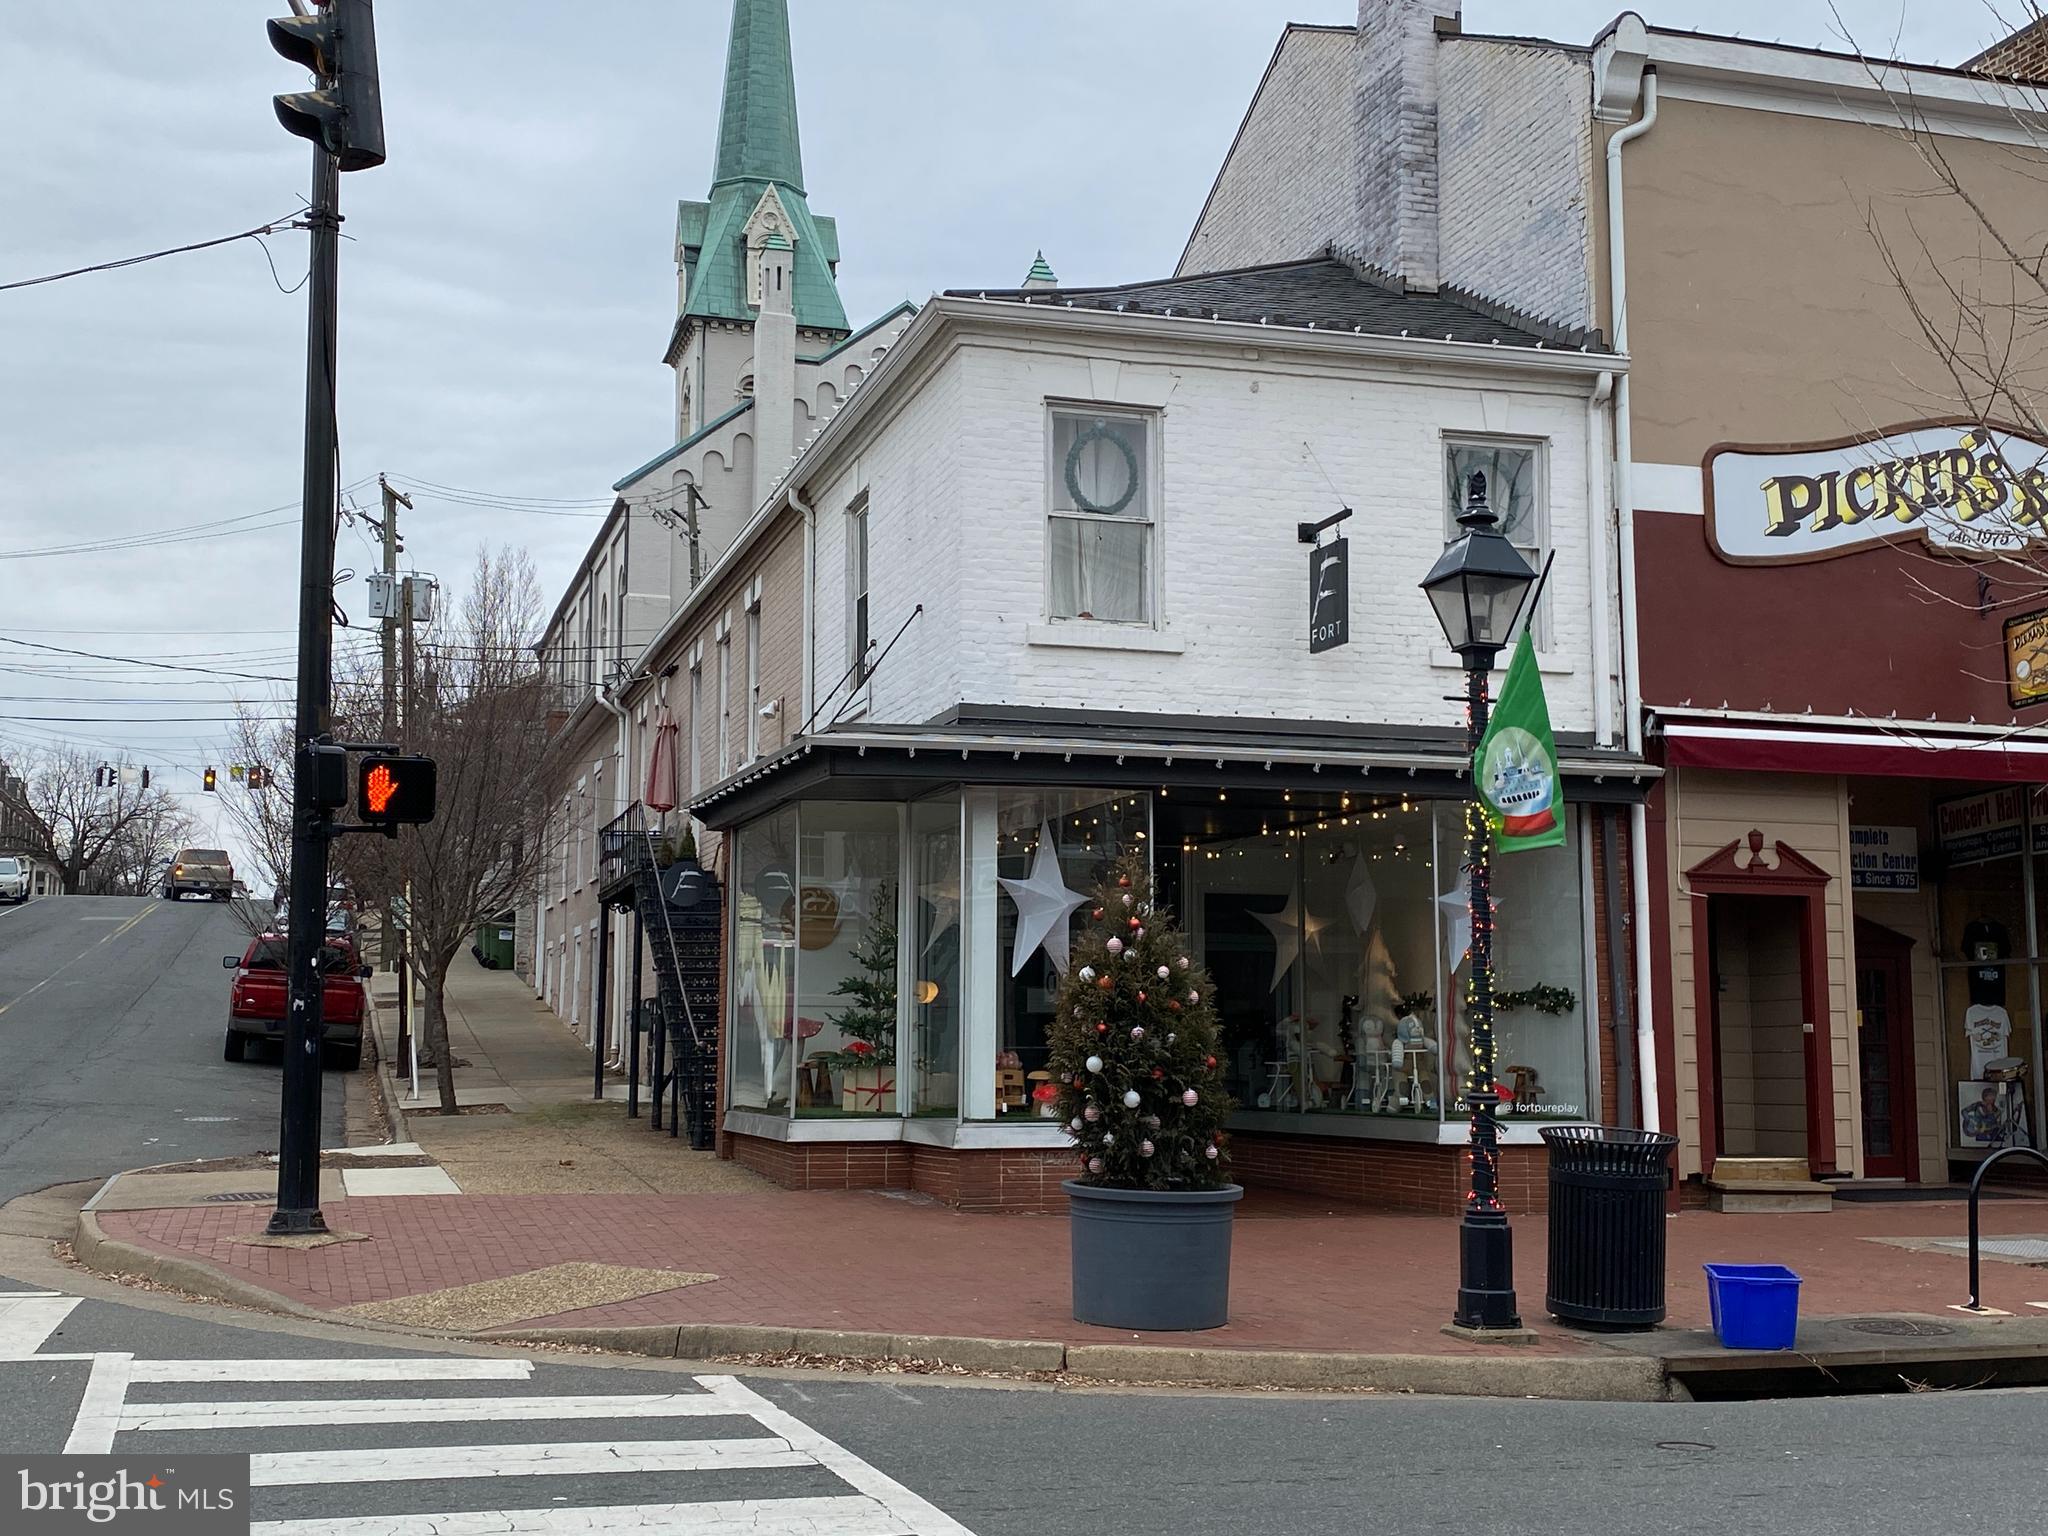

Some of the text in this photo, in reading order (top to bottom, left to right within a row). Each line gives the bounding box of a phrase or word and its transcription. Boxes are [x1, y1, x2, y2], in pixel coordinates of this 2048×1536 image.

[1760, 427, 2008, 538] PICKER'S
[1976, 528, 2010, 547] 1975
[1311, 620, 1342, 644] FORT
[1941, 788, 2021, 835] Concert Hall
[1850, 827, 1889, 847] omplete
[1852, 851, 1917, 870] ction Center
[1865, 872, 1891, 885] Since
[1895, 874, 1916, 886] 1975
[1516, 1102, 1579, 1114] fortpureplay
